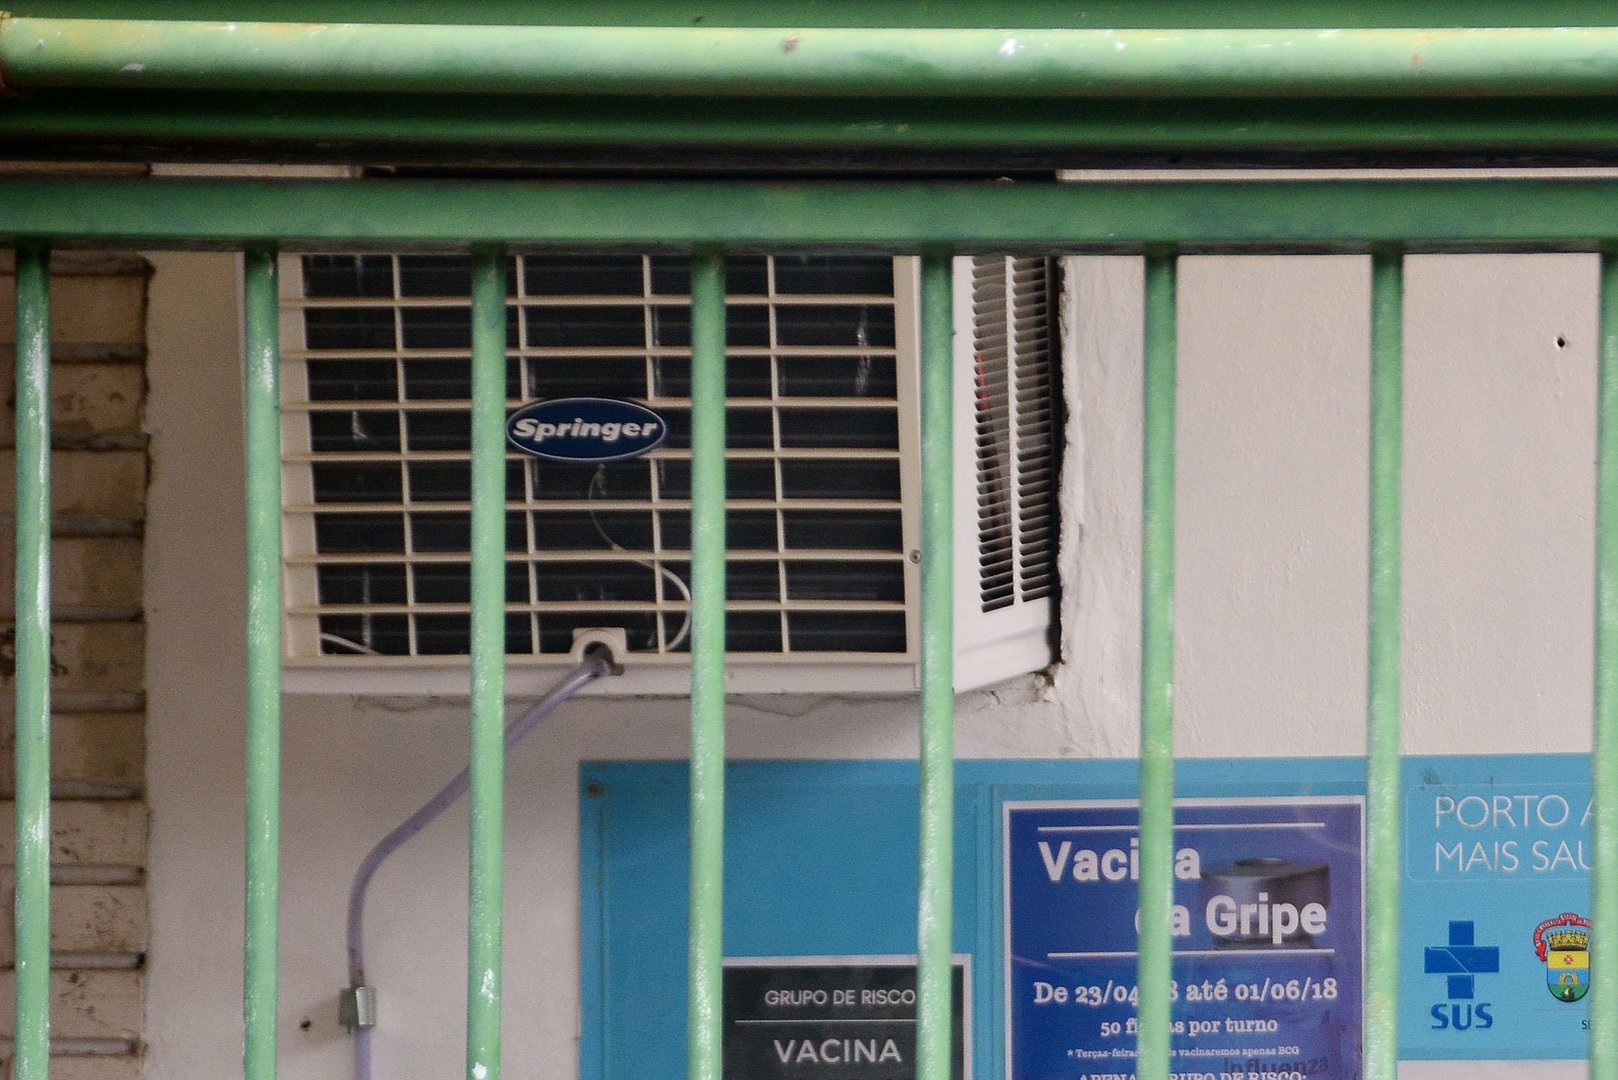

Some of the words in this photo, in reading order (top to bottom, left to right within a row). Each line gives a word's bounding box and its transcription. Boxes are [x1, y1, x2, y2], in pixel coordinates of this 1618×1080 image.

[513, 417, 658, 442] Springer
[1435, 795, 1570, 829] PORTO
[1038, 838, 1201, 882] Vacia
[1435, 839, 1520, 873] MAIS
[1205, 892, 1327, 944] Gripe
[764, 989, 827, 1006] GRUPO
[833, 990, 856, 1006] DE
[861, 988, 917, 1005] RISCO
[1033, 981, 1068, 1004] De
[1186, 977, 1228, 1001] até
[1234, 976, 1338, 1003] 01/06/18
[1100, 1021, 1121, 1037] 50
[1188, 1021, 1221, 1036] por
[1225, 1018, 1278, 1034] turno
[1430, 1002, 1494, 1031] SUS
[773, 1038, 902, 1063] VACINA
[1278, 1045, 1300, 1055] BCG
